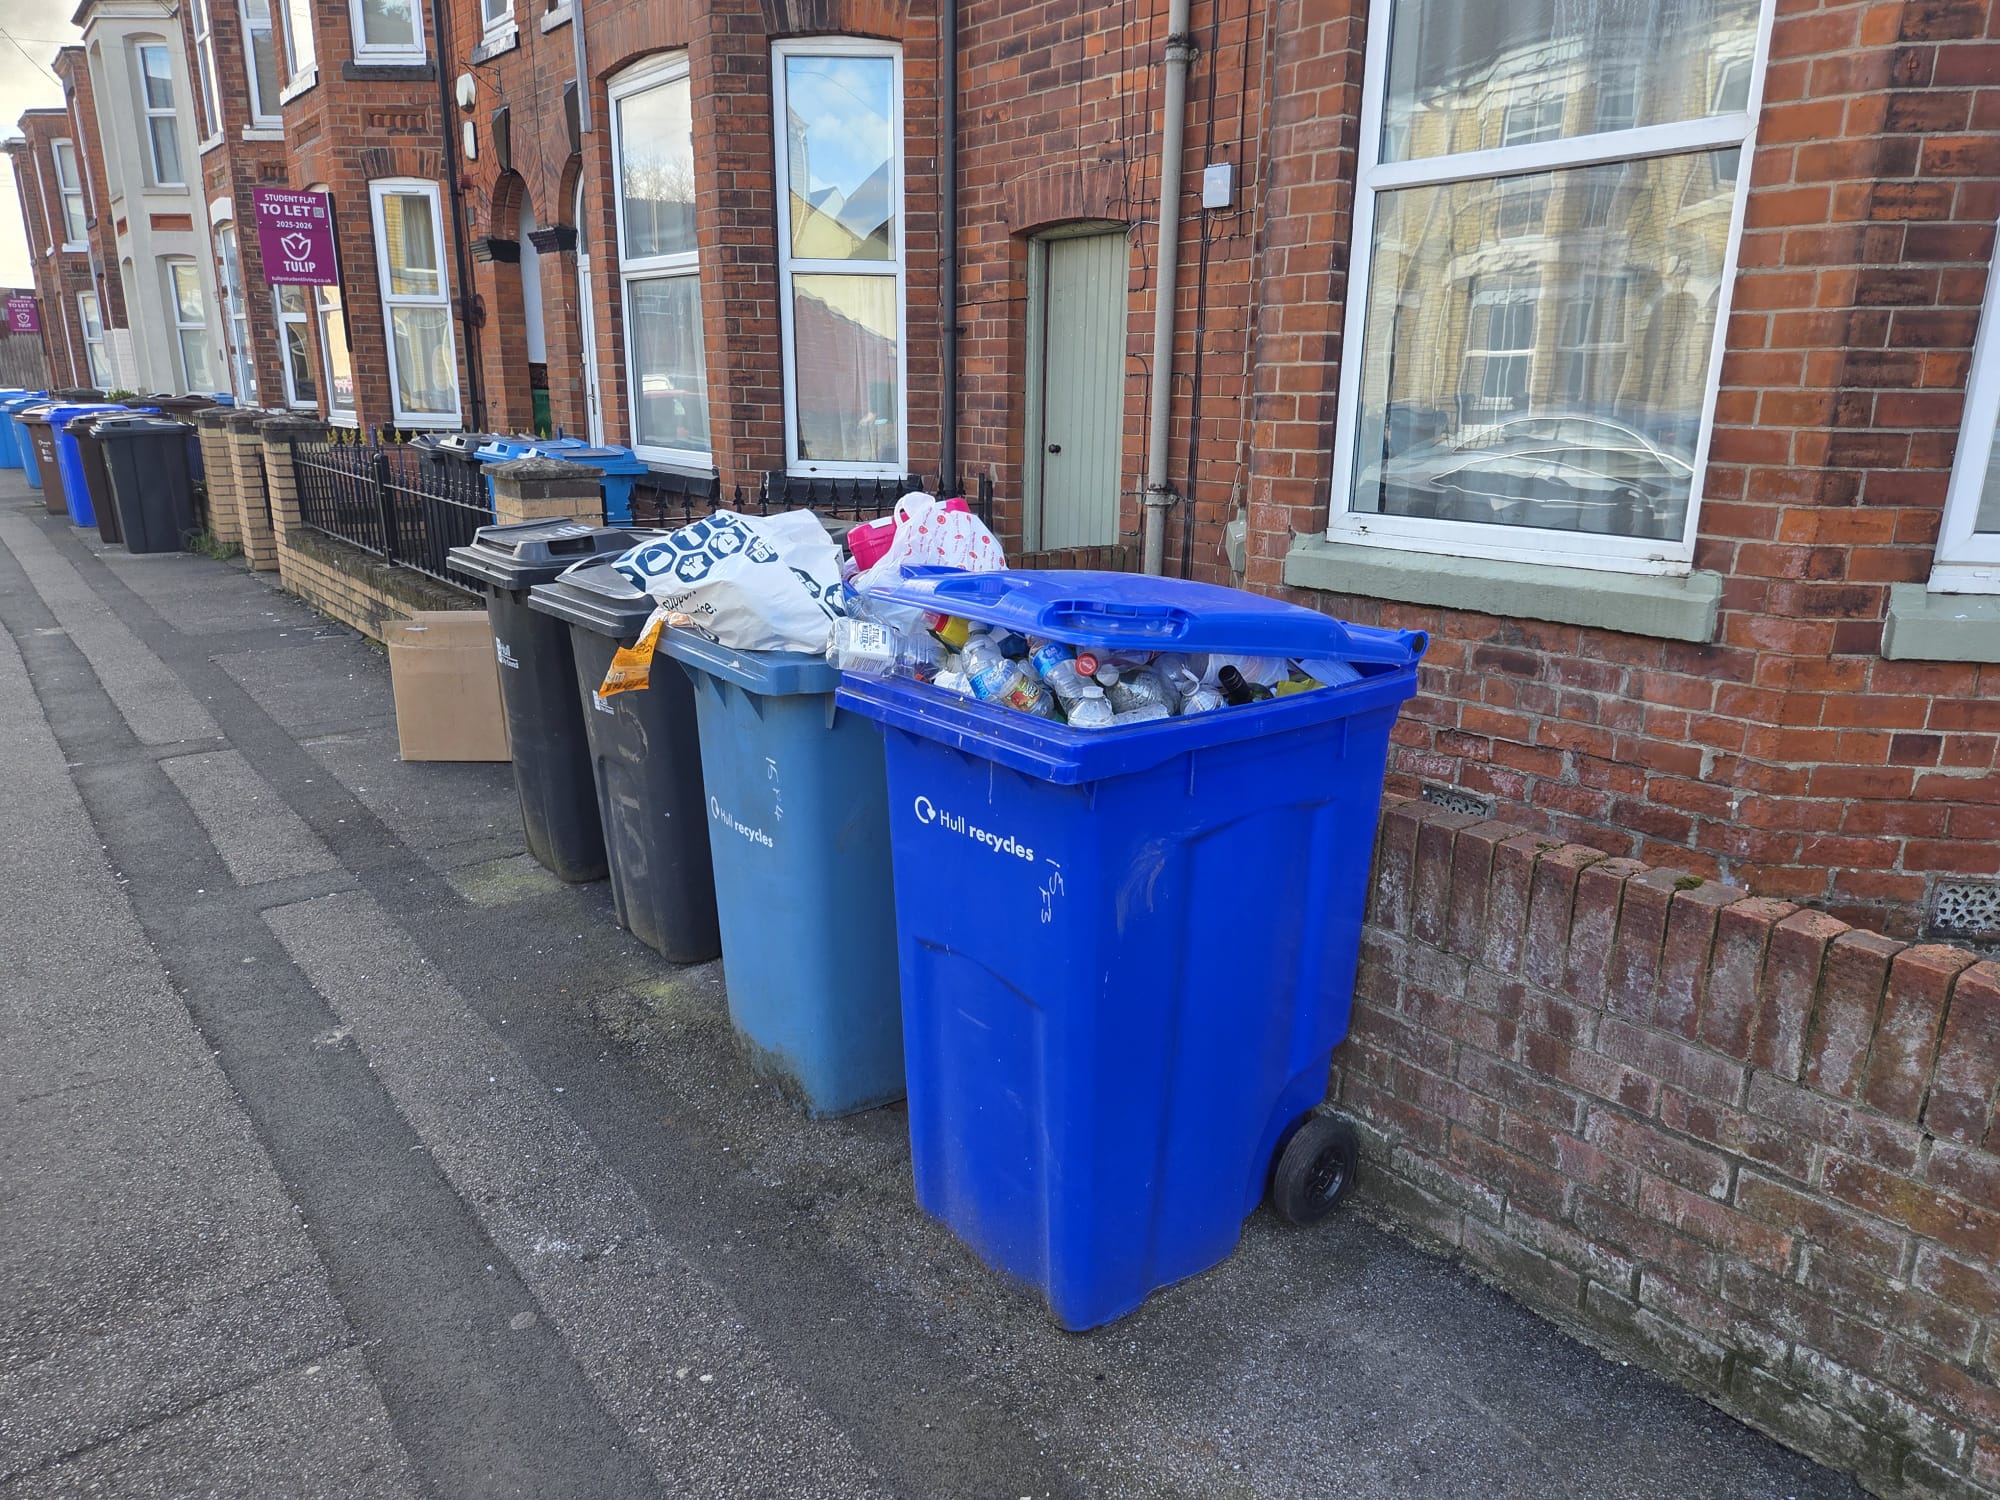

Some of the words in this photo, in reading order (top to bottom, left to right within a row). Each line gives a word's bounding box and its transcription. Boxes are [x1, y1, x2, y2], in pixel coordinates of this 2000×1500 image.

[264, 193, 298, 202] STUDENT
[299, 196, 317, 204] FLAT
[260, 203, 281, 215] TO
[284, 204, 311, 217] LET
[276, 220, 312, 230] 2025-2026
[283, 261, 316, 273] TULIP
[720, 807, 734, 829] Hull
[734, 820, 774, 848] recycles
[940, 809, 965, 835] Hull
[969, 825, 1034, 862] recycles
